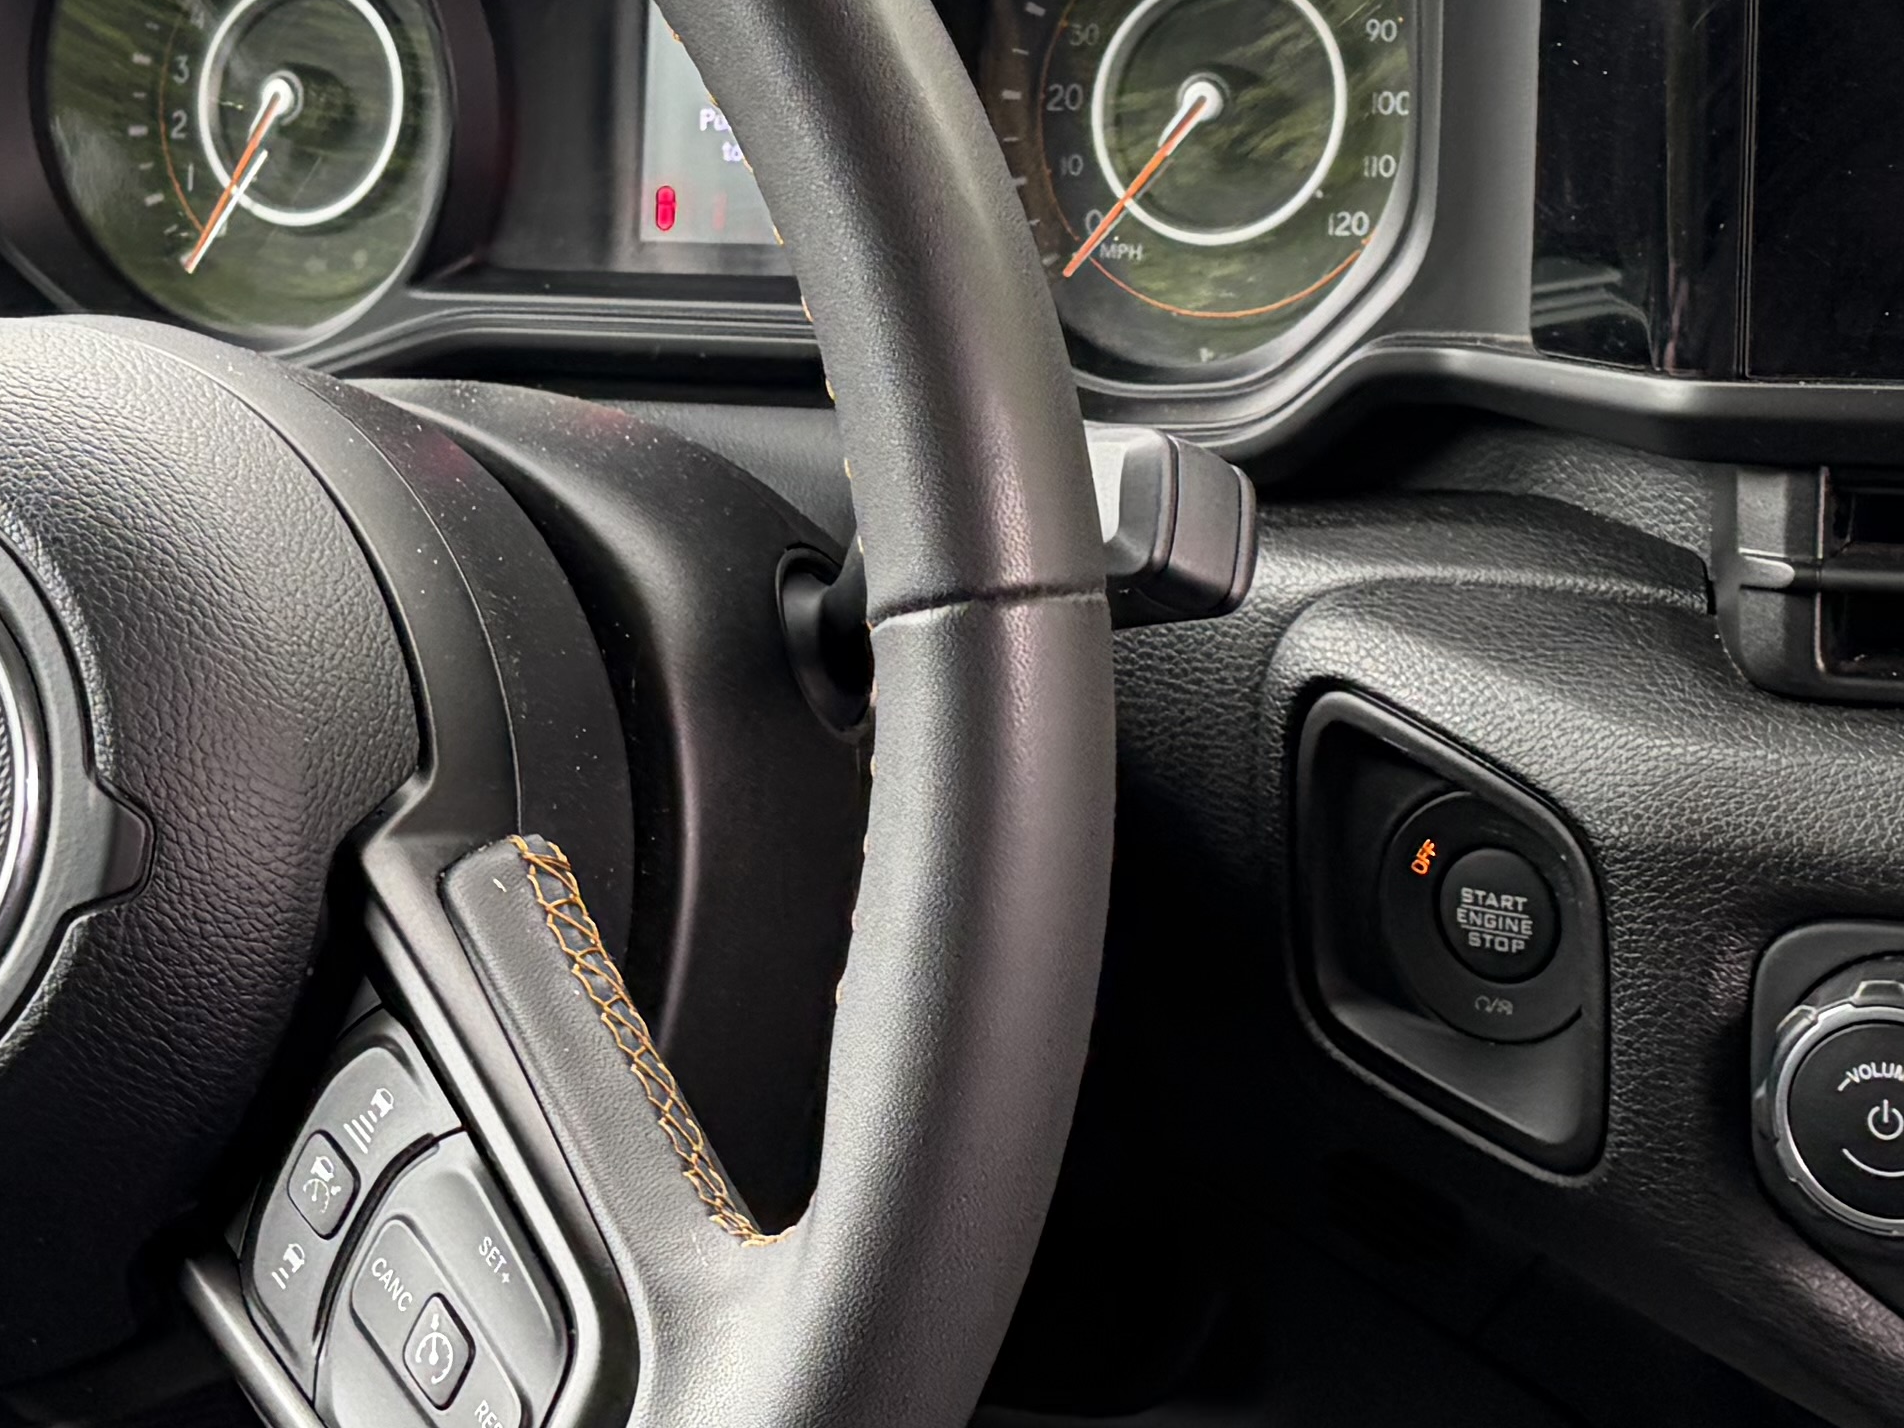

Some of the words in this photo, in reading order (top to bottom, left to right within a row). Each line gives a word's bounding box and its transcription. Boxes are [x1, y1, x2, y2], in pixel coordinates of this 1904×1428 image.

[1365, 18, 1398, 43] 90
[172, 55, 190, 84] 3
[1046, 84, 1084, 113] 20
[170, 110, 188, 139] 2
[1362, 154, 1397, 178] 110
[1326, 210, 1370, 239] 120
[1099, 242, 1144, 261] MPH
[1410, 837, 1437, 876] OFF
[1460, 886, 1529, 913] START
[1456, 907, 1534, 936] ENGINE
[1467, 931, 1526, 954] STOP
[370, 1256, 414, 1313] CANC
